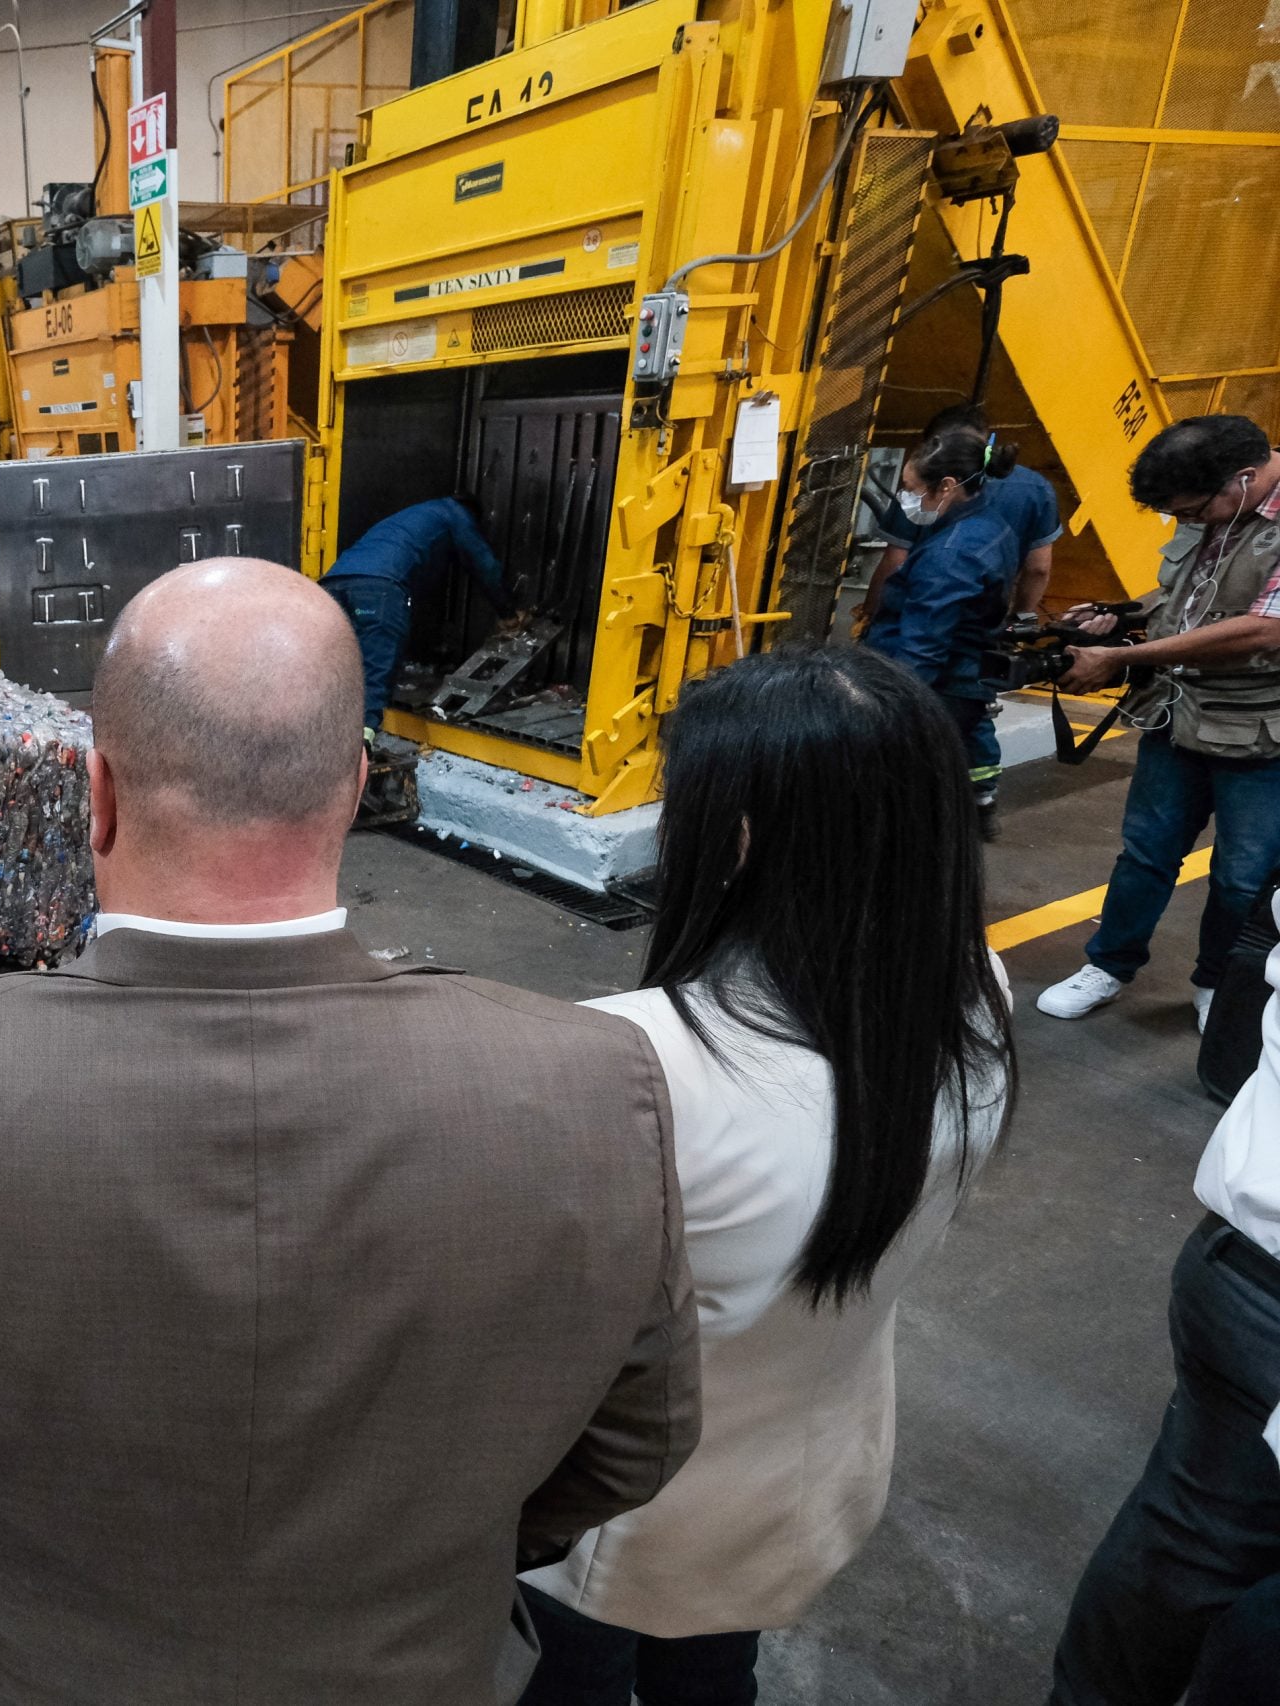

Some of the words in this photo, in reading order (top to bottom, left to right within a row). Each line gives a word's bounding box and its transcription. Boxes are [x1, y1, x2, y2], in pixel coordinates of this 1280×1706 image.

[435, 277, 464, 296] TEN
[469, 266, 513, 290] SIXTY
[45, 303, 74, 339] EJ-06
